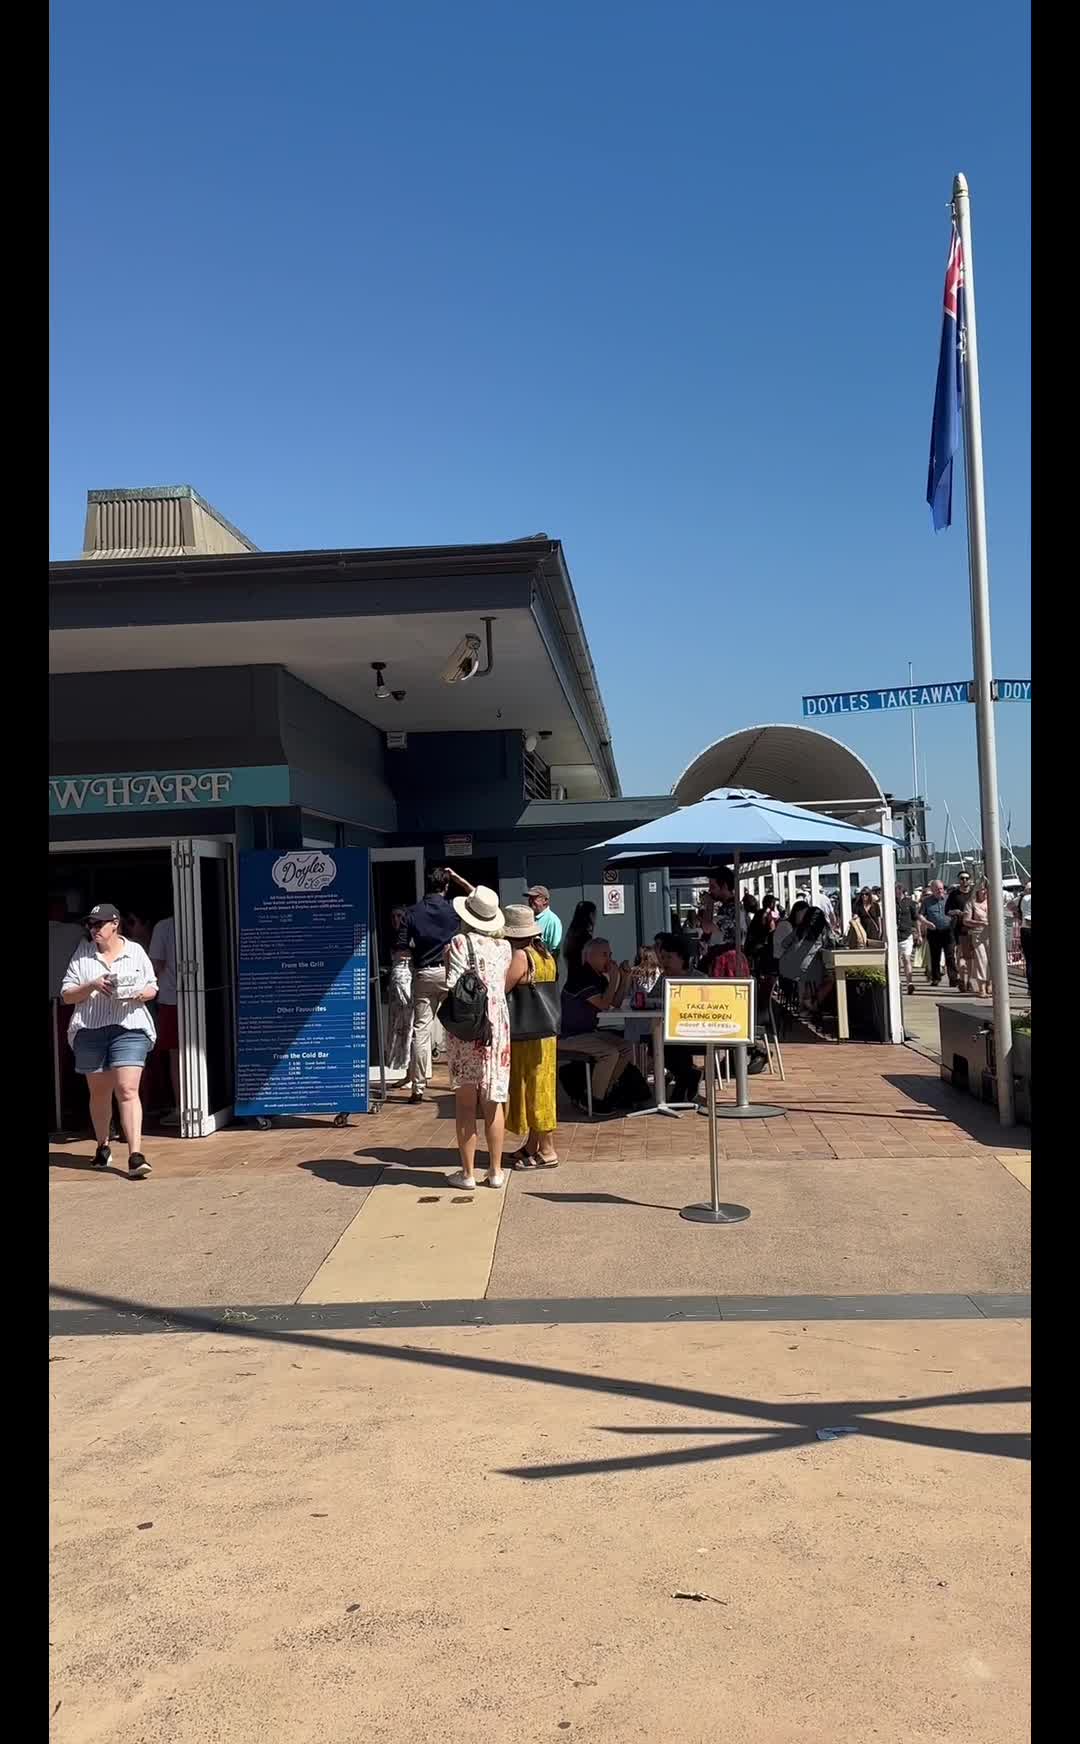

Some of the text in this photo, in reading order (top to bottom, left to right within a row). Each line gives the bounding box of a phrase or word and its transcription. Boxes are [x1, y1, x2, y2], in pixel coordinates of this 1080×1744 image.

[806, 684, 964, 715] DOYLES TAKEAWAY
[1003, 682, 1031, 699] DOY
[49, 772, 233, 808] WHARF
[282, 855, 326, 888] Doyles
[679, 1012, 732, 1020] SEATING OPEN
